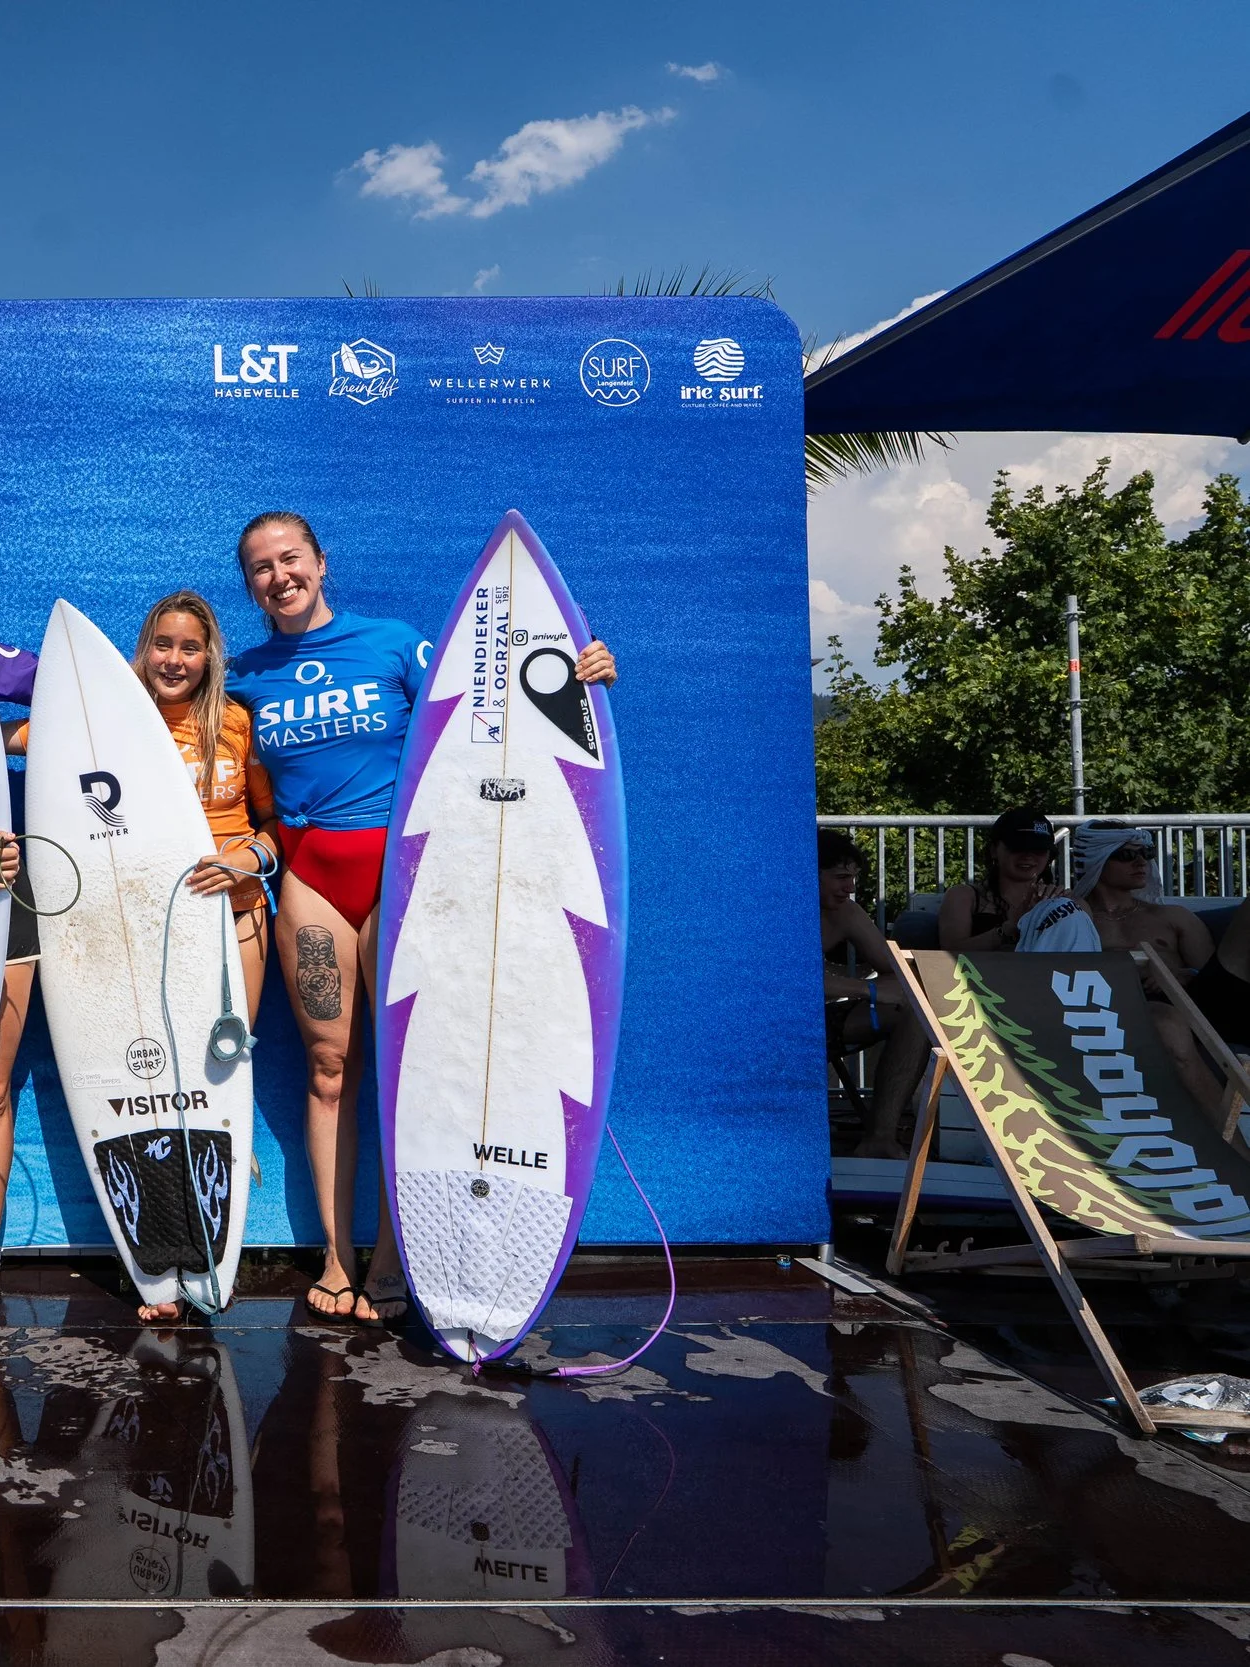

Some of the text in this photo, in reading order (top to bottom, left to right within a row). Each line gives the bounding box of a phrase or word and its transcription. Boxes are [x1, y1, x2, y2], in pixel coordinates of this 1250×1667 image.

[214, 344, 298, 384] L&T
[588, 357, 641, 378] SURF
[215, 388, 300, 398] HASEWELLE
[328, 376, 399, 399] RheinRiff
[429, 378, 551, 388] WELLENWERK
[680, 385, 713, 400] irie
[502, 585, 510, 602] 1912
[472, 587, 489, 708] NIENDIEKER
[532, 632, 568, 642] aniwyle
[493, 611, 509, 708] & OGRZAL
[294, 660, 335, 686] O2
[258, 682, 381, 731] SURF
[258, 711, 388, 751] MASTERS
[89, 827, 129, 841] RIVVER
[130, 1047, 160, 1059] URBAN
[132, 1058, 162, 1071] SURF
[107, 1090, 209, 1117] VISITOR
[473, 1143, 548, 1170] WELLE
